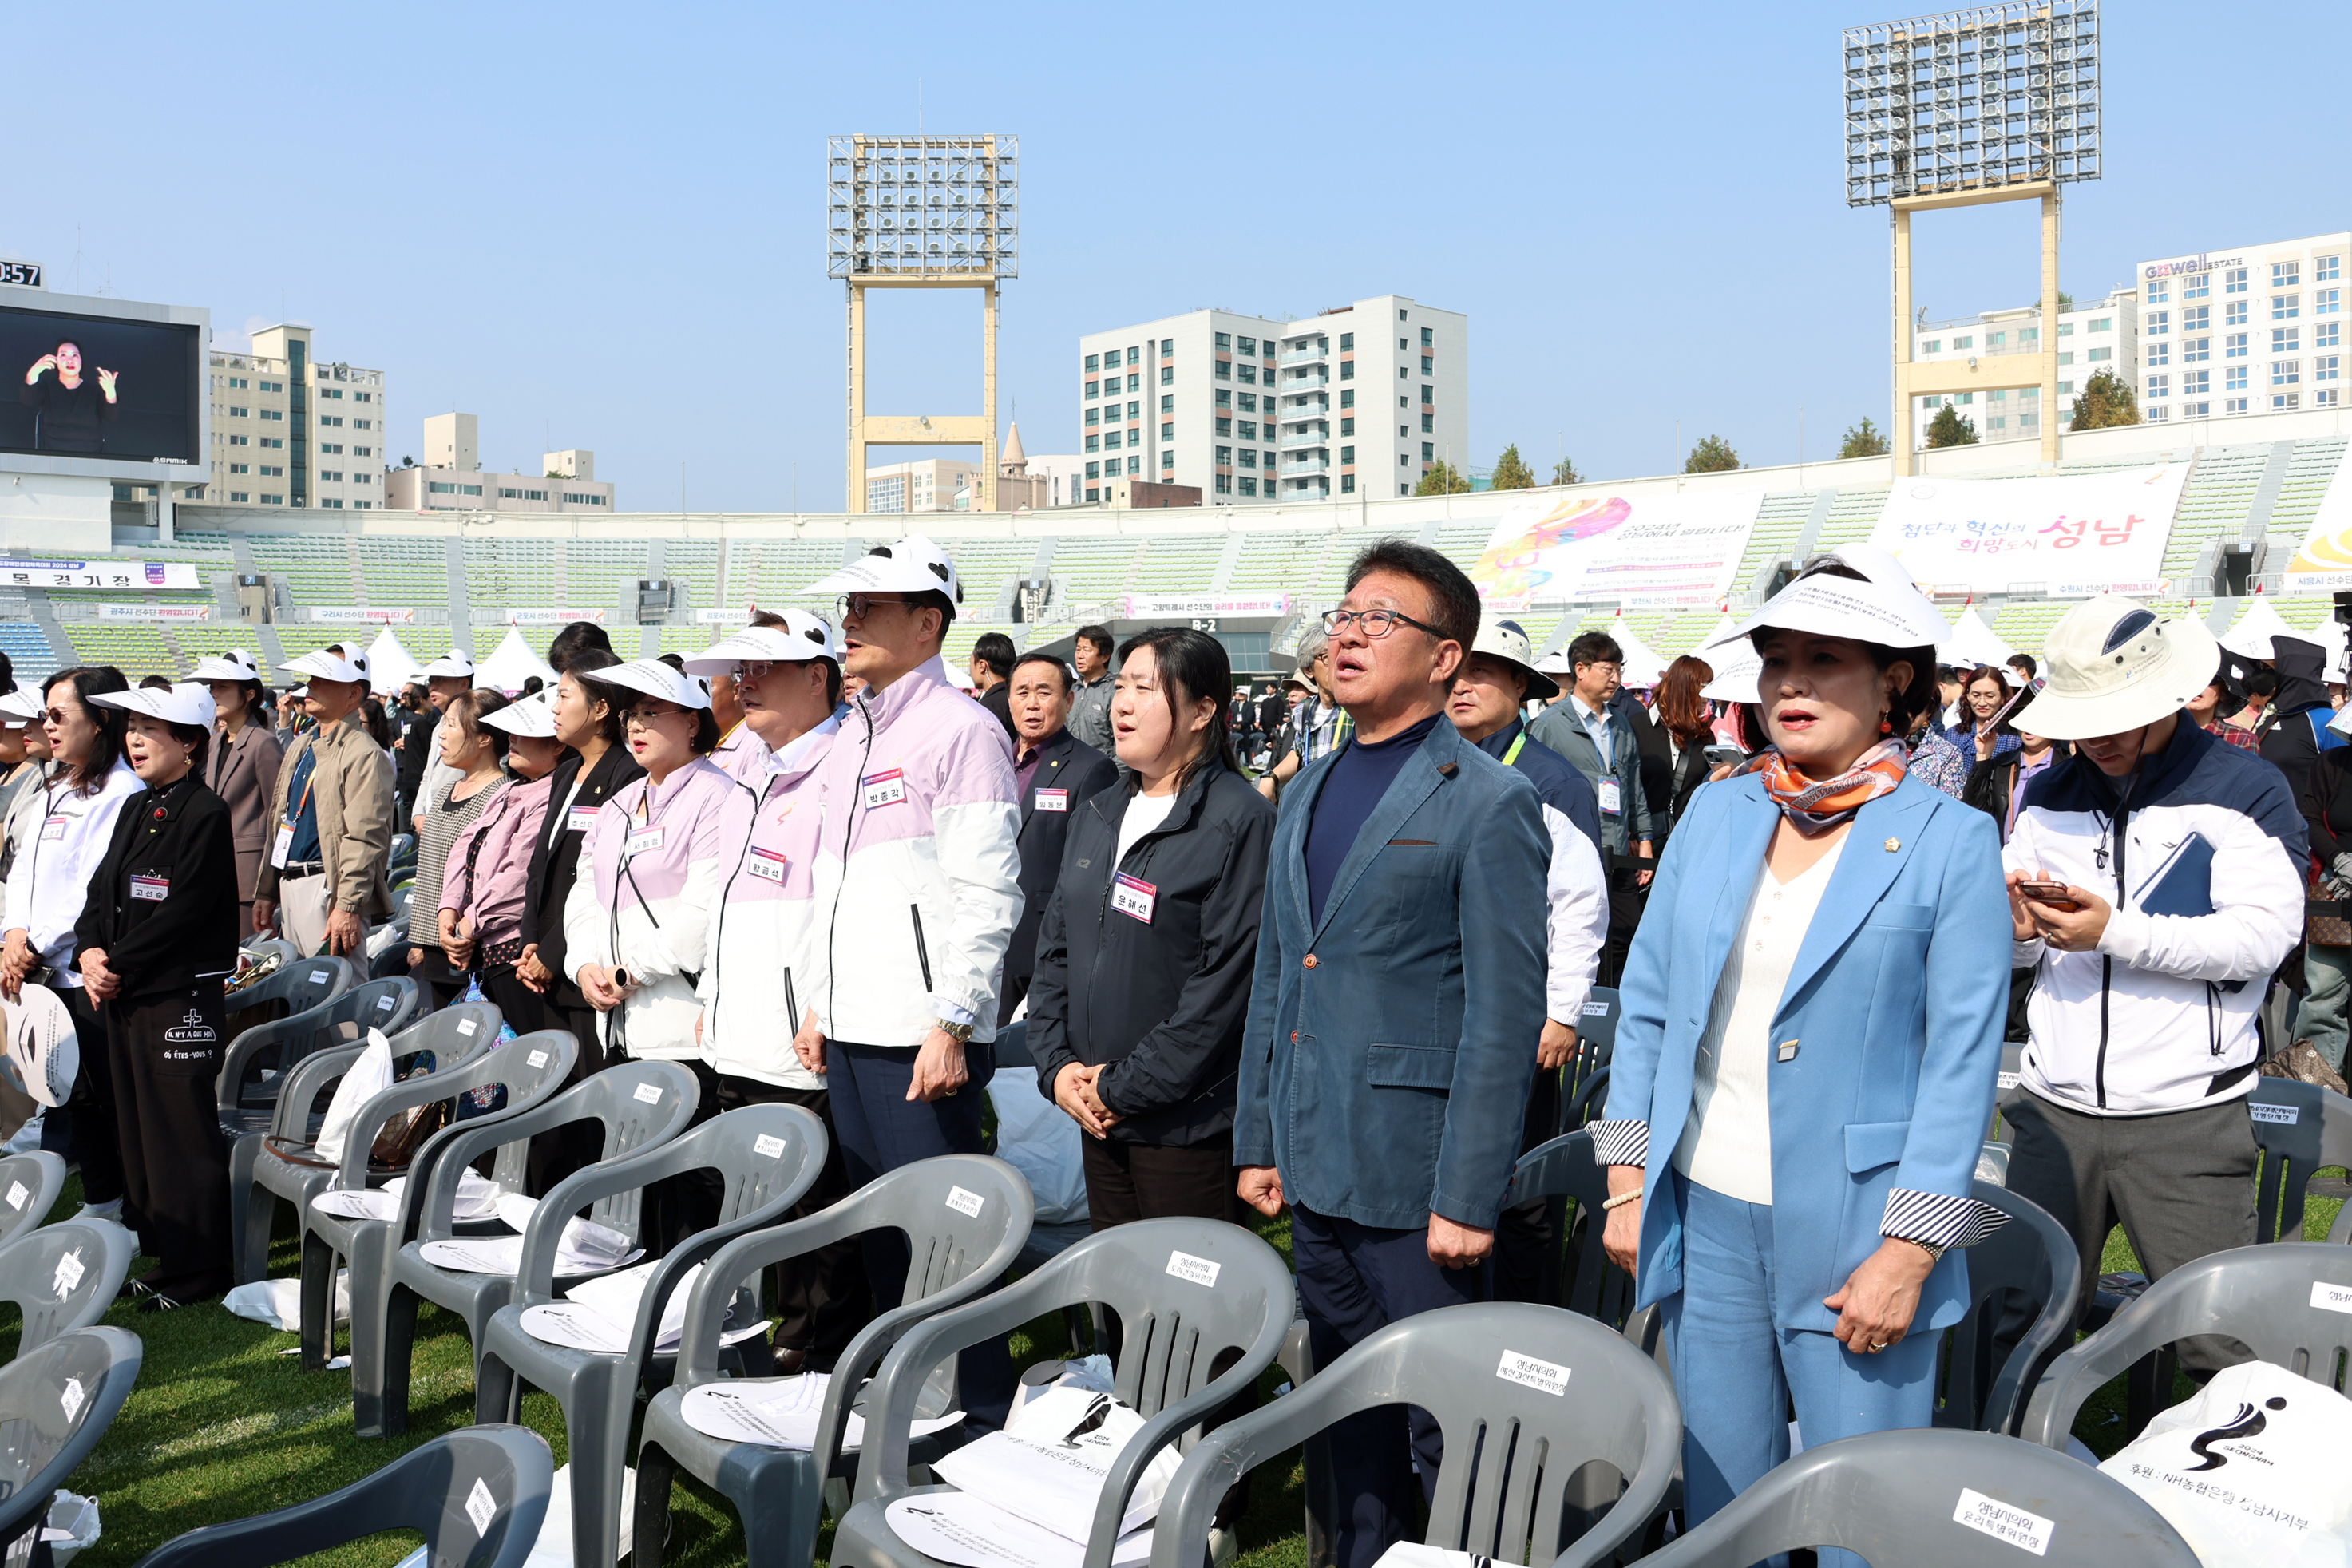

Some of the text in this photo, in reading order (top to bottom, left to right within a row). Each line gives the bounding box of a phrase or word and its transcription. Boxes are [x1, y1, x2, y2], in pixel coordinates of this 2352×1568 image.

[2208, 258, 2242, 270] ESTATE
[1617, 524, 1746, 540] 성남에서 열립니다!
[1623, 522, 1681, 533] 2024년
[1900, 519, 2026, 538] 첨단과 혁신의
[1956, 514, 2145, 553] 희망도시 성남
[2240, 543, 2251, 552] 12
[1793, 560, 1802, 569] 11
[13, 573, 30, 584] 목
[2298, 576, 2323, 585] 시흥시
[2085, 584, 2109, 593] 선수단
[2111, 583, 2157, 592] 환영합니다!
[1675, 596, 1714, 604] 환영합니다!
[1151, 603, 1185, 612] 고양특례시
[1865, 604, 1887, 614] 2024
[1891, 613, 1907, 624] 성남
[366, 611, 404, 620] 환영합니다!
[559, 612, 596, 620] 환영합니다!
[706, 612, 747, 621] 김포시 선수단
[1192, 620, 1216, 632] B-2
[1877, 615, 1900, 628] 2024
[1903, 626, 1919, 637] 성남
[870, 787, 899, 803] 박종각
[1076, 857, 1091, 869] K2
[753, 863, 779, 878] 황금석
[136, 889, 163, 899] 고선순
[1118, 895, 1146, 914] 윤혜선
[957, 1192, 977, 1206] 성남시의회
[1180, 1258, 1210, 1273] 성남시의회
[1170, 1265, 1212, 1284] 도시건설위원장
[1517, 1359, 1557, 1380] 성남시의회
[1499, 1366, 1566, 1393] 예산결산특별위원장
[2223, 1445, 2275, 1466] SEONGNAM
[2237, 1443, 2263, 1455] 2024
[1068, 1458, 1110, 1477] 성남시지부
[2129, 1464, 2154, 1479] 후원
[2162, 1473, 2235, 1505] NH농협은행
[2239, 1496, 2309, 1531] 성남시지부
[1978, 1502, 2033, 1532] 성남시의회
[1964, 1511, 2039, 1549] 윤리특별위원장
